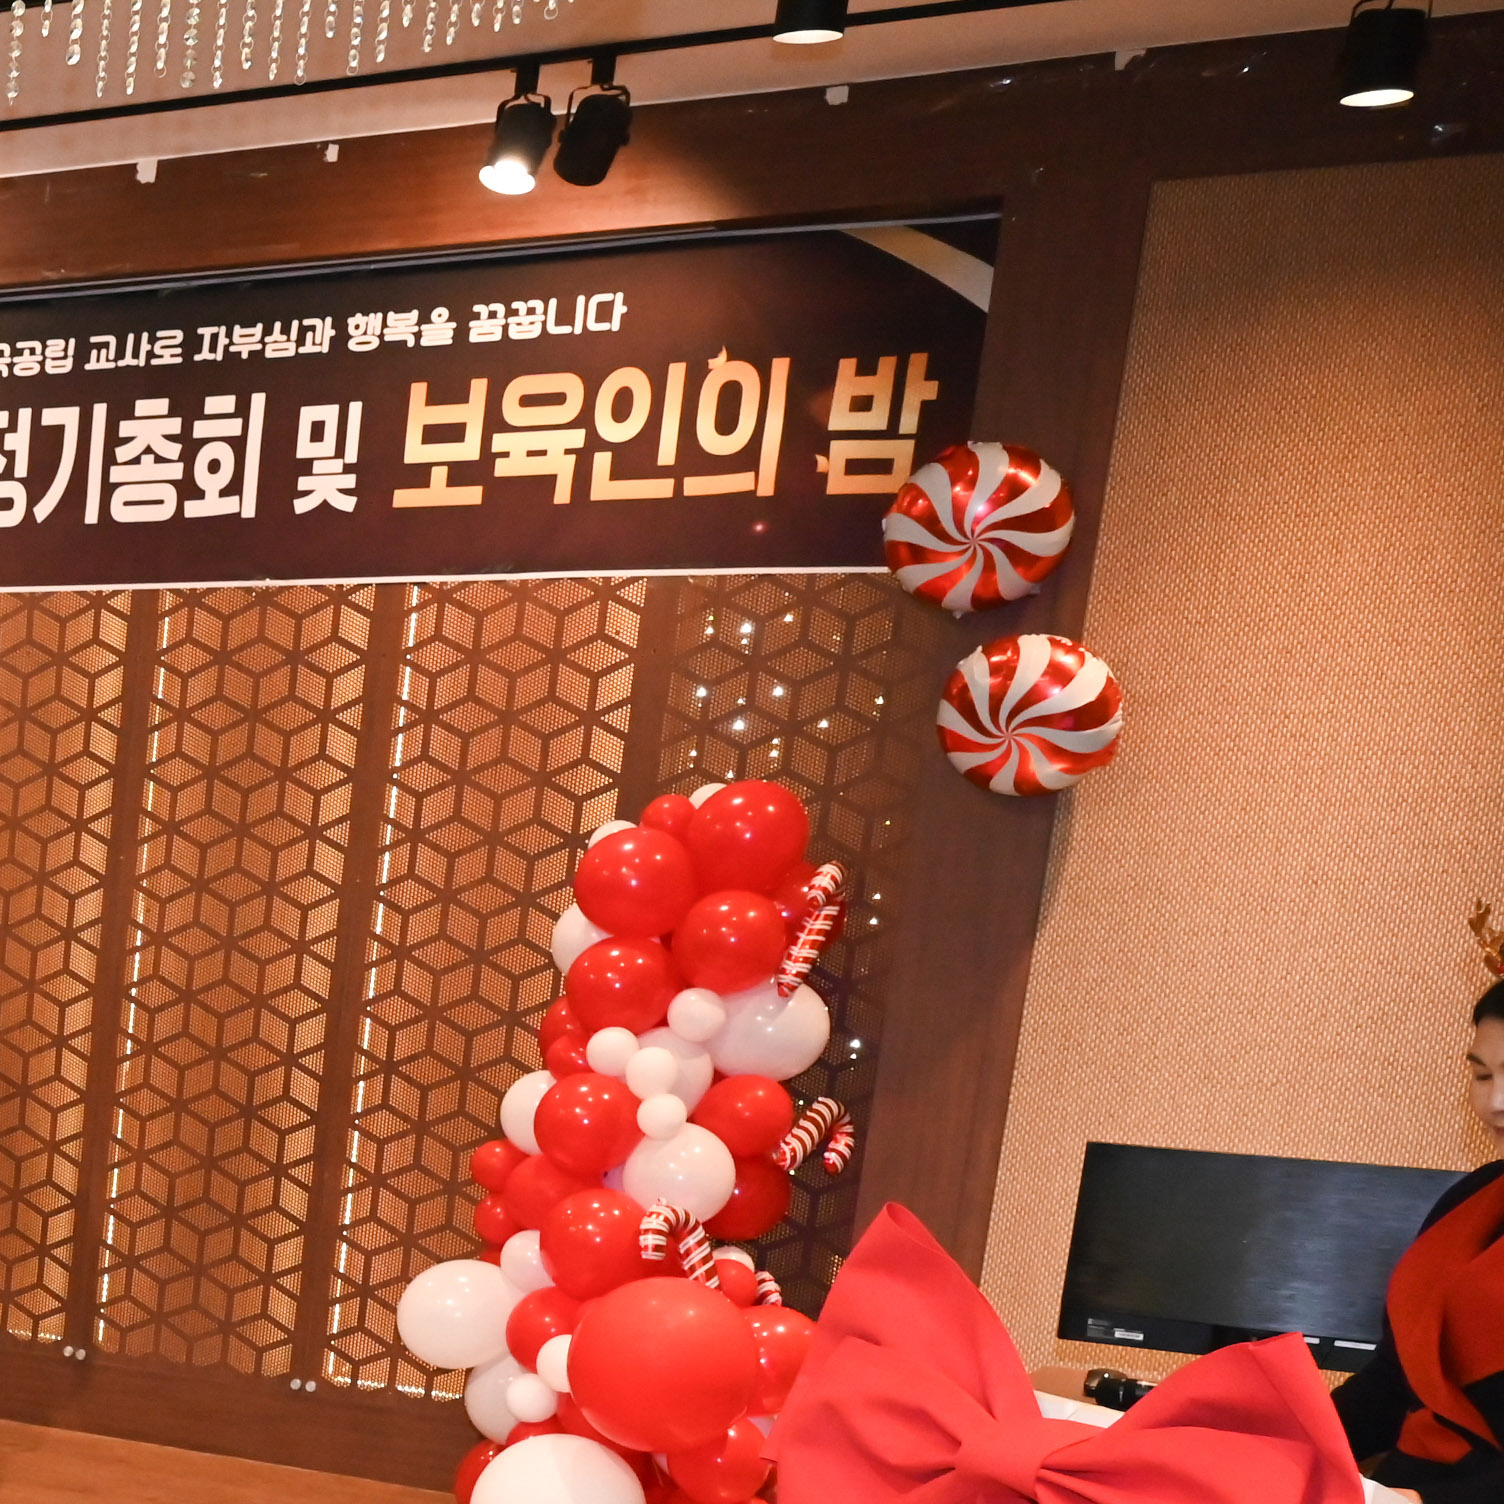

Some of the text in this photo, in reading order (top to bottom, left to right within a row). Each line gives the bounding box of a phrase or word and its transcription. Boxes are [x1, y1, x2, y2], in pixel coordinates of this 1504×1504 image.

[84, 329, 184, 371] 교사로
[193, 316, 336, 362] 자부심과
[346, 306, 458, 352] 행복을
[468, 291, 628, 343] 꿈꿉니다
[292, 400, 363, 515] 및
[392, 346, 791, 509] 보육인의
[820, 352, 940, 496] 밤
